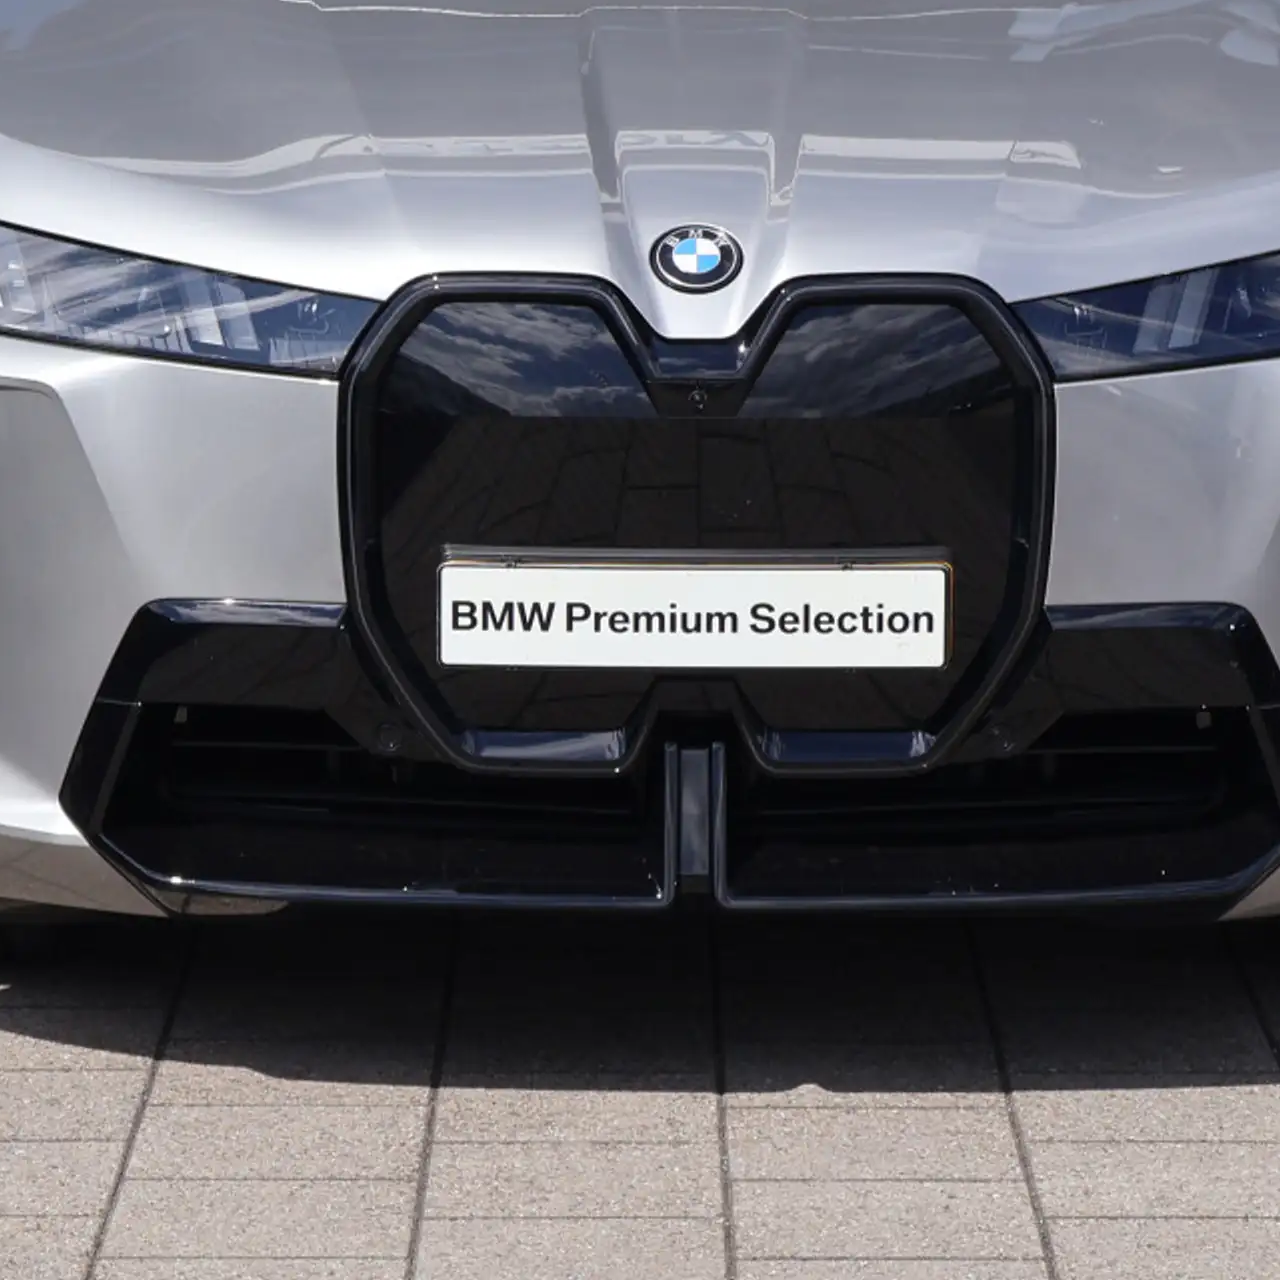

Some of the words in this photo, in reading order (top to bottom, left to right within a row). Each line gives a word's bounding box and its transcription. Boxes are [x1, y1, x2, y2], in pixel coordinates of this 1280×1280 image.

[451, 600, 556, 632] BMW
[566, 601, 739, 634] Premium
[748, 602, 934, 635] Selection
